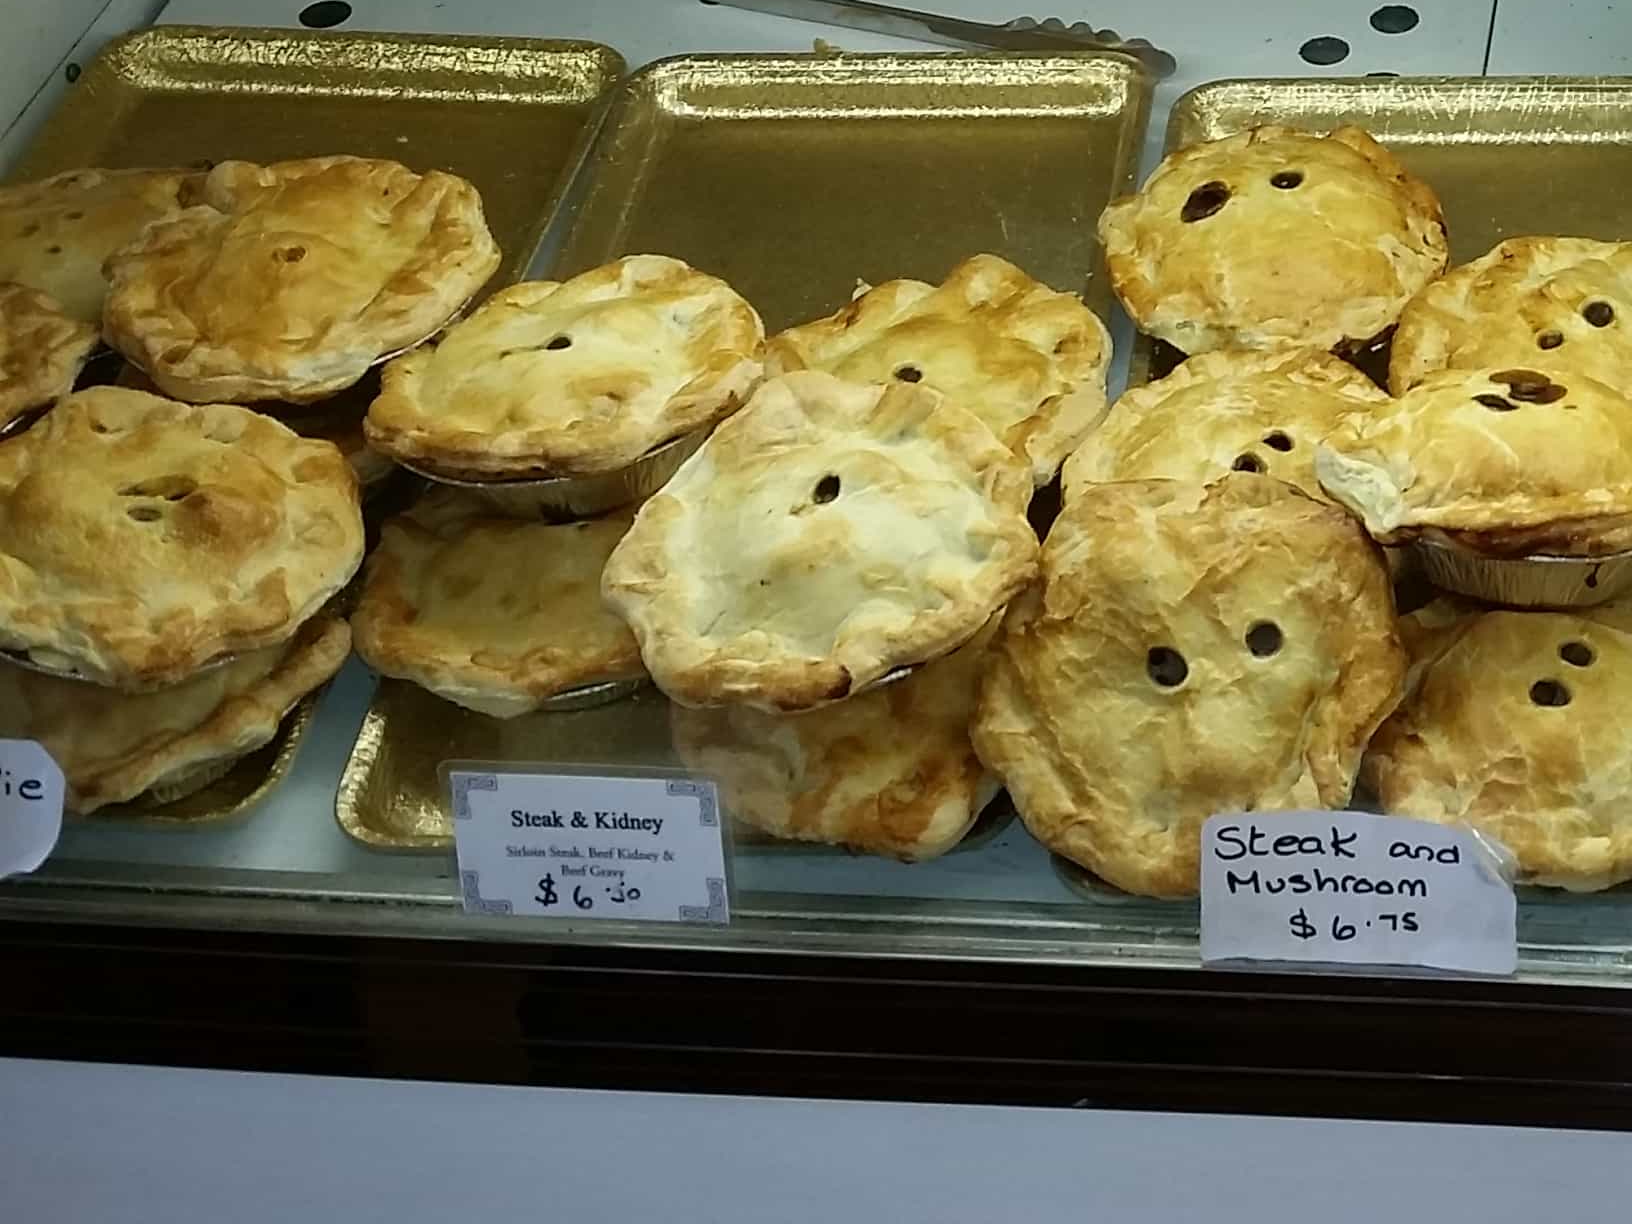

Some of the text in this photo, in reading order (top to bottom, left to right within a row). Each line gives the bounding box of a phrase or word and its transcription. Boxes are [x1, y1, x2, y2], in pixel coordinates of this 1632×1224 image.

[0, 768, 43, 800] ie
[511, 810, 663, 835] Steak & Kidney
[588, 848, 615, 859] Beef
[1214, 826, 1460, 864] Steak and
[560, 864, 589, 876] Beef
[1226, 868, 1427, 897] Mushroom
